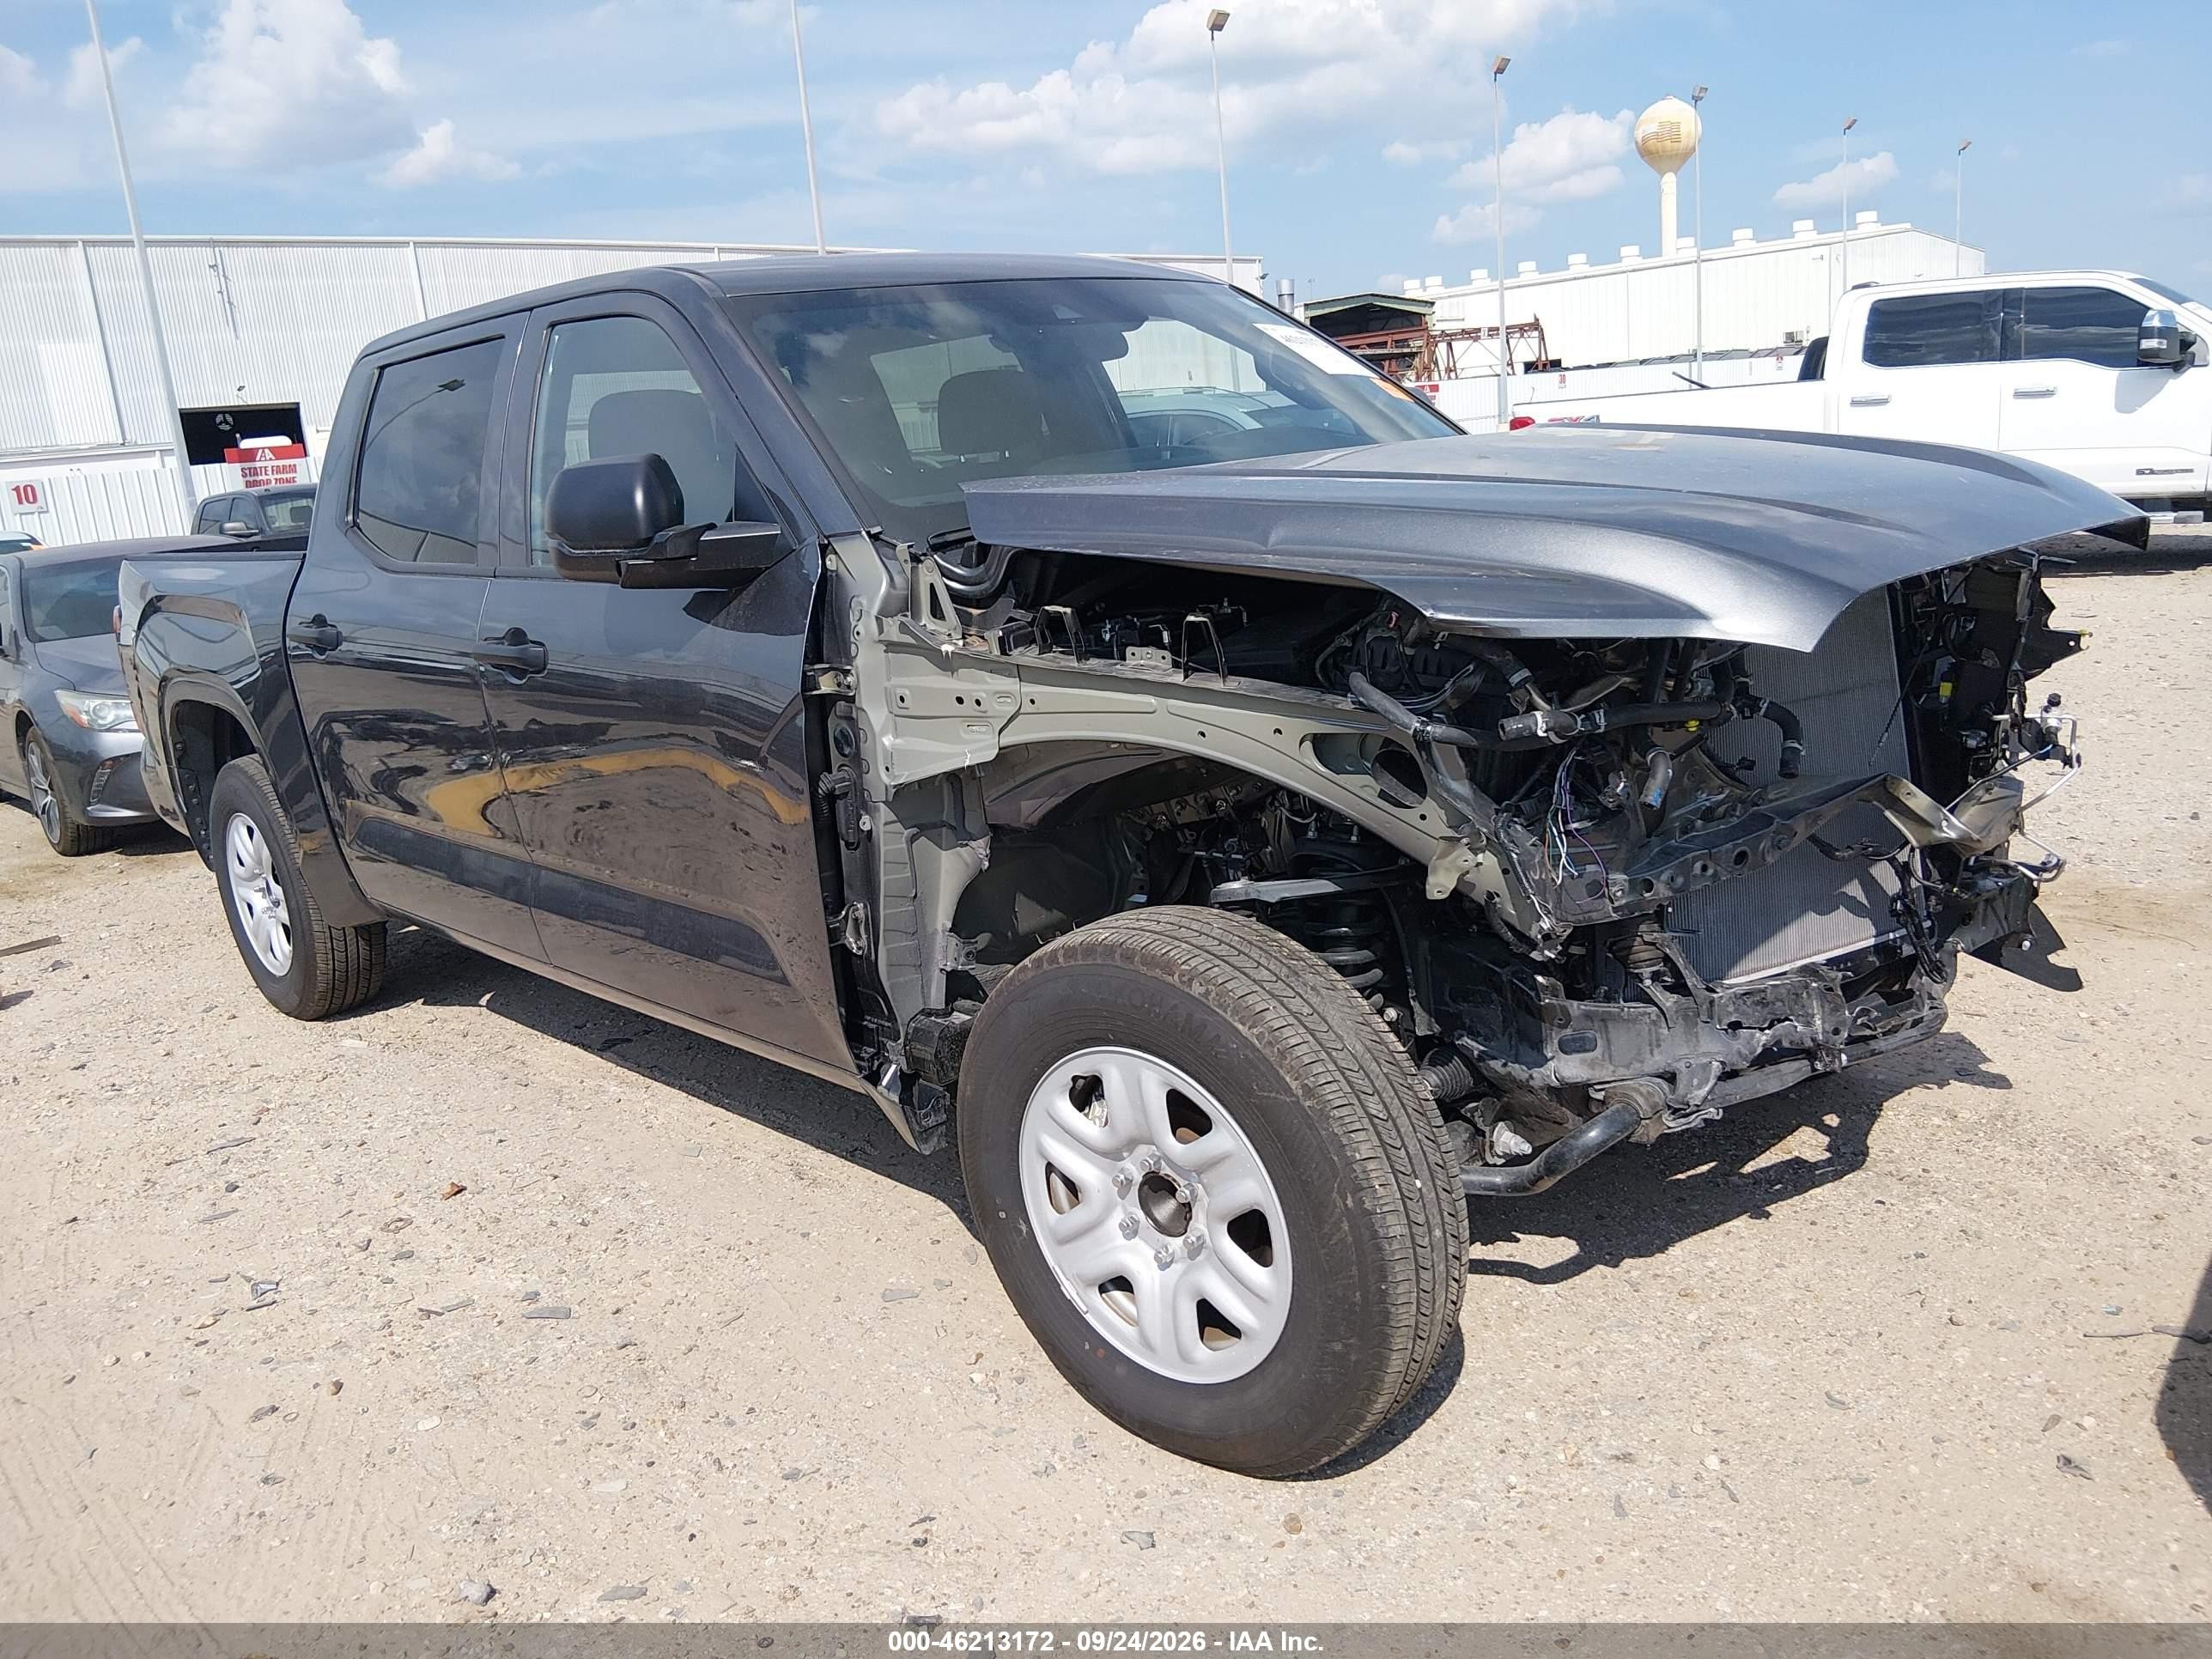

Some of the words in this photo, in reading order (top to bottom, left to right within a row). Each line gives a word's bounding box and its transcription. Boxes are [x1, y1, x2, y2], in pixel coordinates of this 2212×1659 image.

[240, 465, 270, 478] STATE
[271, 464, 297, 475] FARM
[246, 479, 272, 489] DROP
[11, 484, 37, 505] 10
